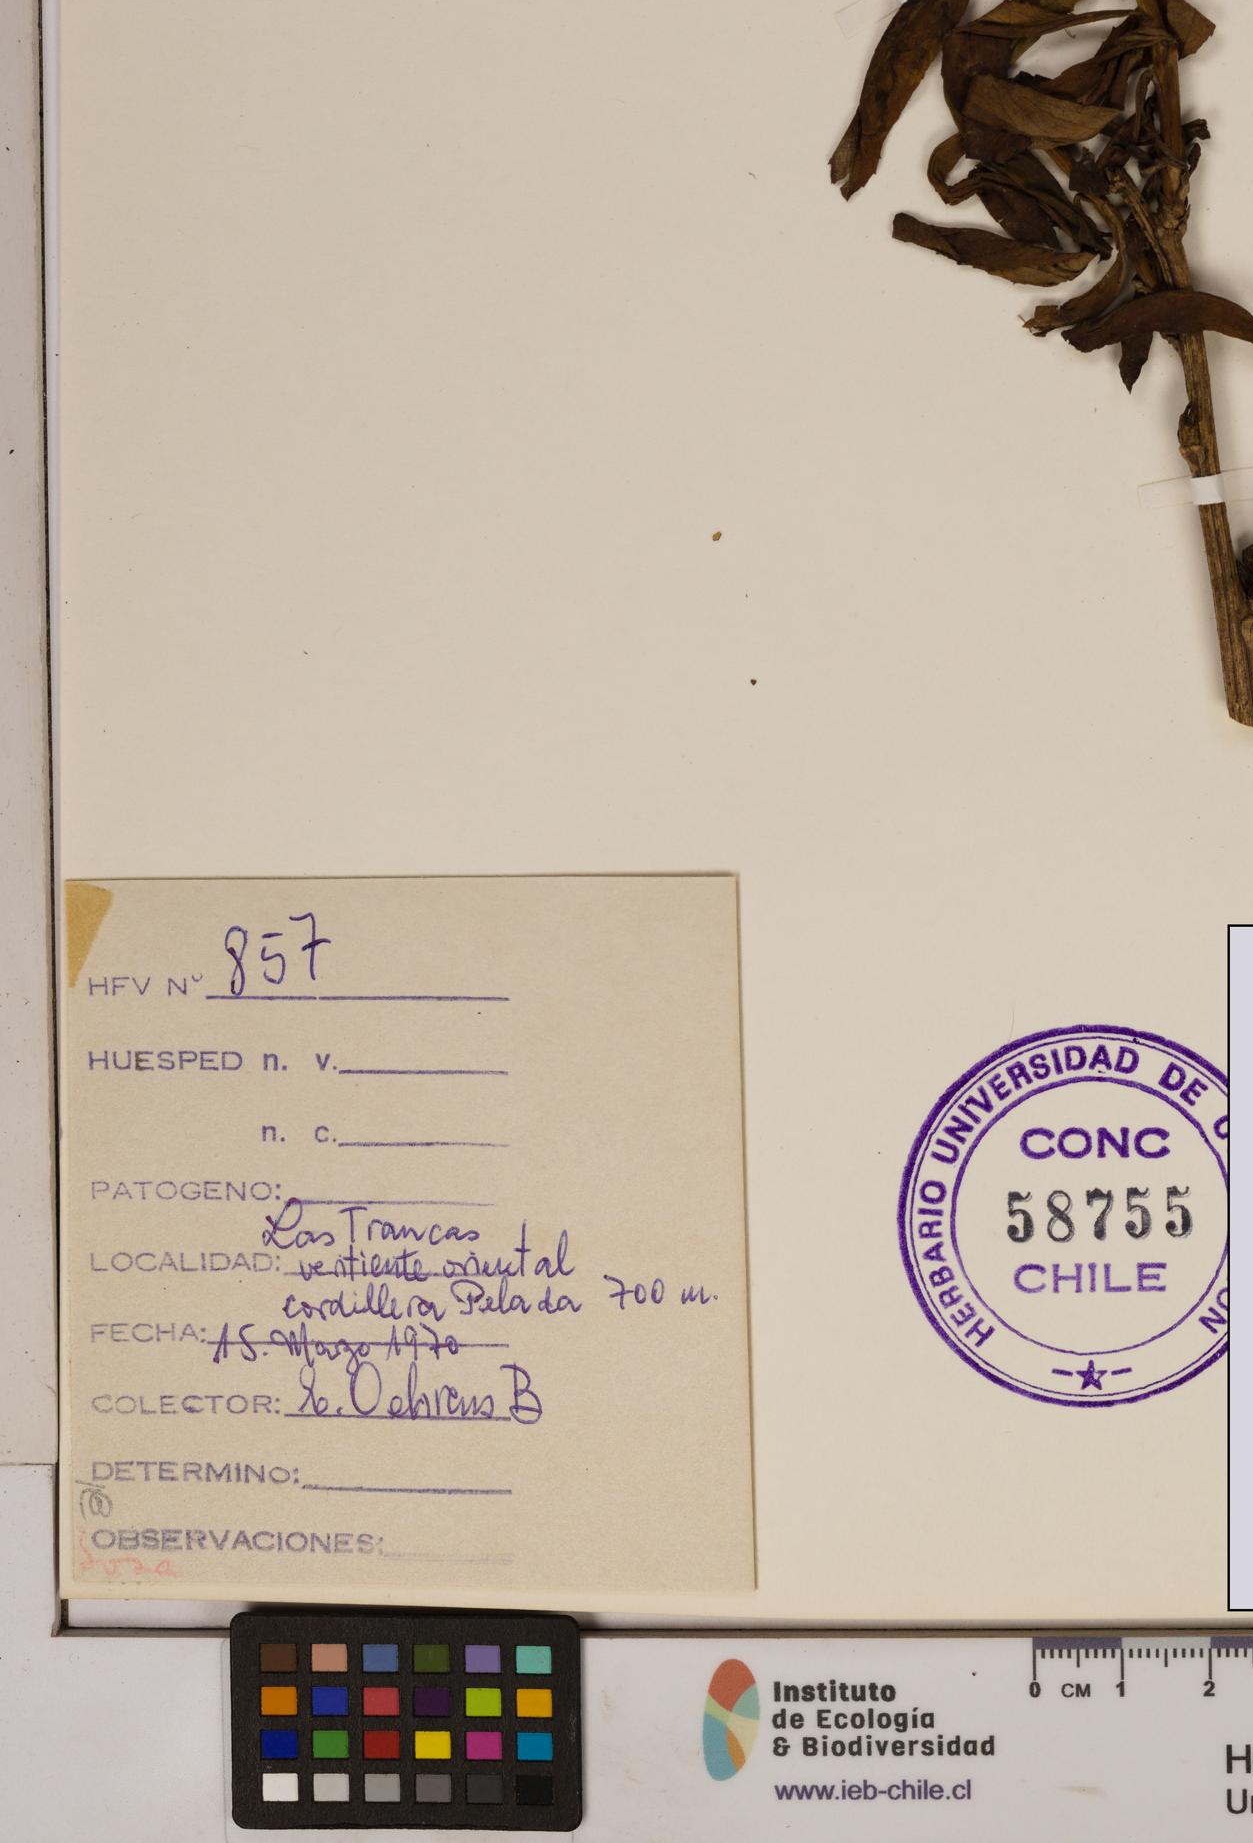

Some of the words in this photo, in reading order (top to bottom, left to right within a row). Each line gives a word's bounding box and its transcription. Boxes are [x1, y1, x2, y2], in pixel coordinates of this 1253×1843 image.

[89, 977, 150, 996] HFV
[225, 912, 331, 996] 857
[88, 1050, 243, 1071] HUESPED
[263, 1053, 287, 1071] n.
[315, 1053, 337, 1071] v.
[1159, 1062, 1209, 1106] DE
[931, 1044, 1140, 1165] UNIVERSIDAD
[262, 1125, 286, 1142] n.
[314, 1126, 336, 1143] c.
[1020, 1127, 1171, 1159] CONC
[91, 1181, 281, 1201] PATOGENO:
[262, 1197, 335, 1249] Las
[339, 1206, 480, 1246] Trancas
[1006, 1186, 1193, 1243] 58755
[91, 1252, 280, 1272] LOCALIDAD:
[918, 1180, 995, 1347] HERBARIO
[1014, 1262, 1167, 1293] CHILE
[602, 1274, 664, 1310] 700
[91, 1323, 206, 1343] FECHA:
[386, 1323, 460, 1361] 1970
[91, 1394, 281, 1414] COLECTOR:
[92, 1461, 299, 1484] DETERMINO:
[91, 1528, 384, 1554] OBSERVACIONES:
[773, 1679, 896, 1703] Instituto
[1029, 1682, 1041, 1698] 0
[1061, 1683, 1091, 1698] CM
[1115, 1680, 1126, 1698] 1
[1202, 1680, 1216, 1698] 2
[772, 1708, 805, 1730] de
[816, 1707, 935, 1733] Ecología
[772, 1736, 791, 1757] &
[802, 1735, 995, 1757] Biodiversidad
[774, 1779, 972, 1801] www.ieb-chile.cl
